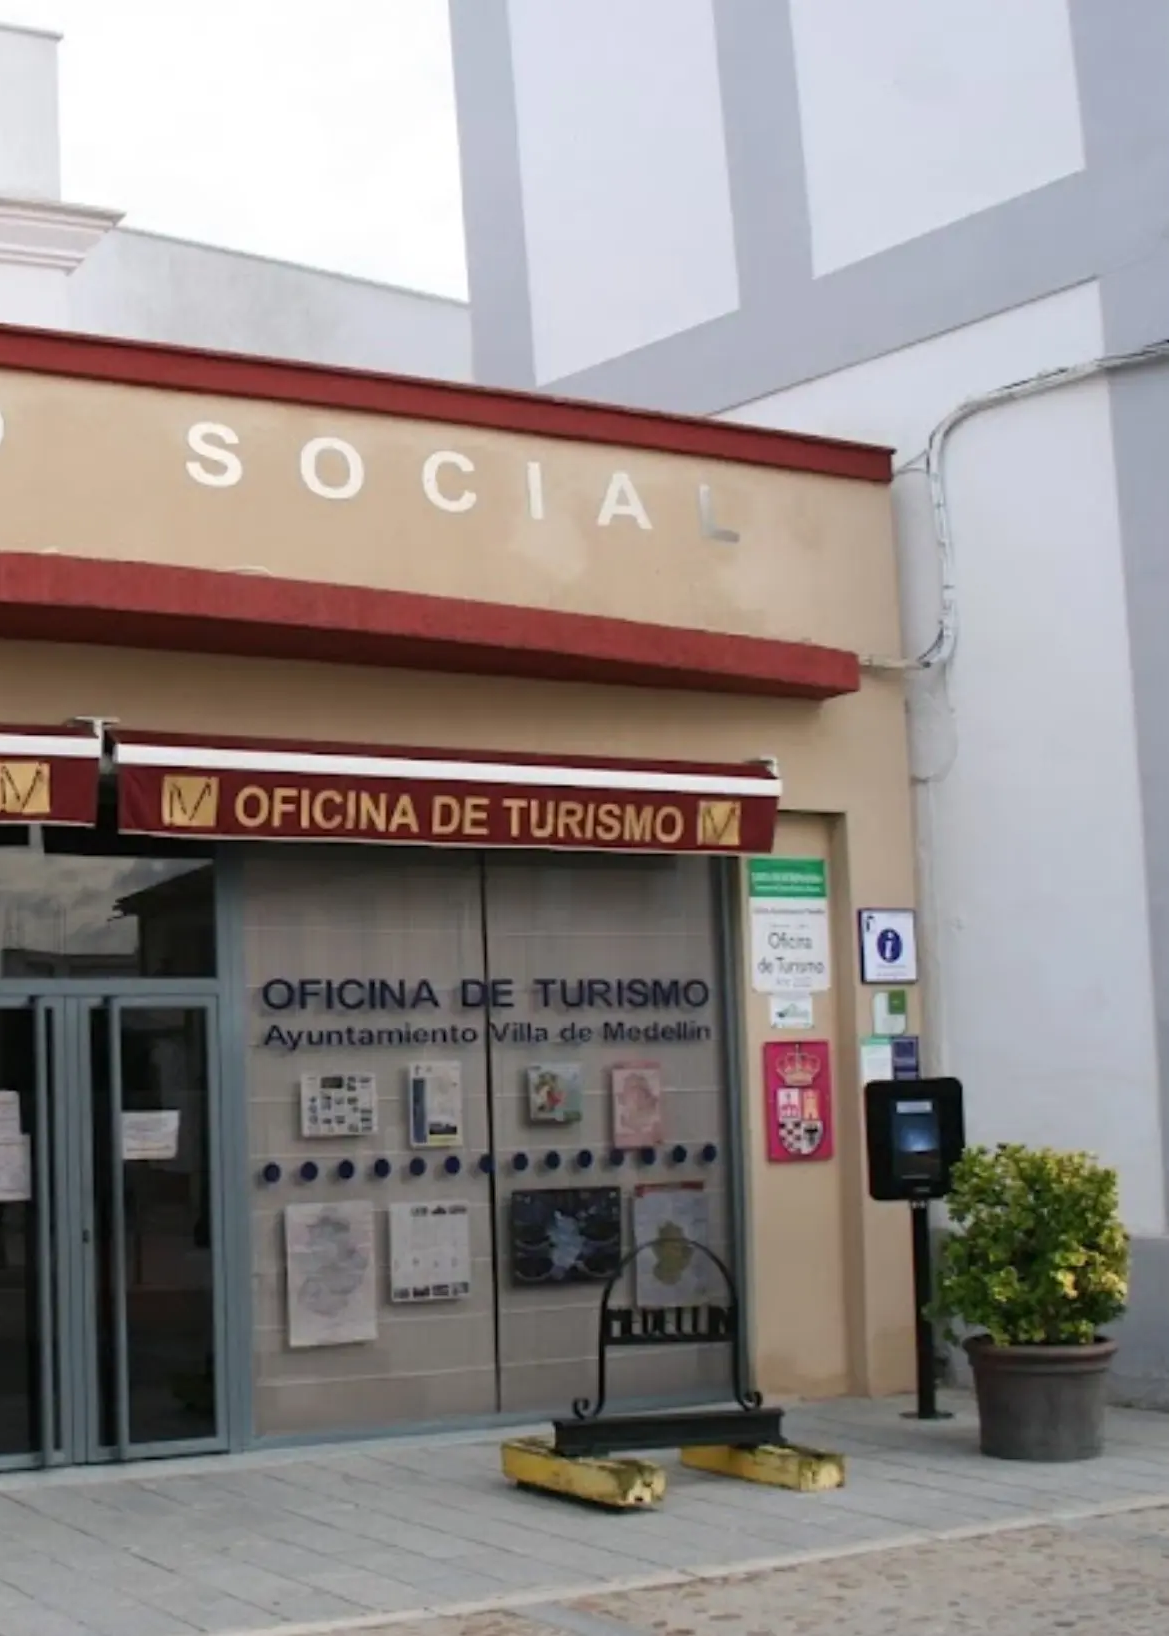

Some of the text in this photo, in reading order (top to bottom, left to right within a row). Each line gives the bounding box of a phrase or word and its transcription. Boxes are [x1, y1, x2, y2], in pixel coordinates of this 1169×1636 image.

[184, 420, 741, 544] SOCIAL
[234, 785, 684, 843] OFICINA DE TURISMO
[768, 932, 813, 950] Oficina
[757, 957, 825, 975] de Turismo
[262, 979, 710, 1011] OFICINA DE TURISMO
[263, 1024, 478, 1054] Ayuntamiento
[491, 1022, 549, 1044] Villa
[560, 1022, 592, 1043] de
